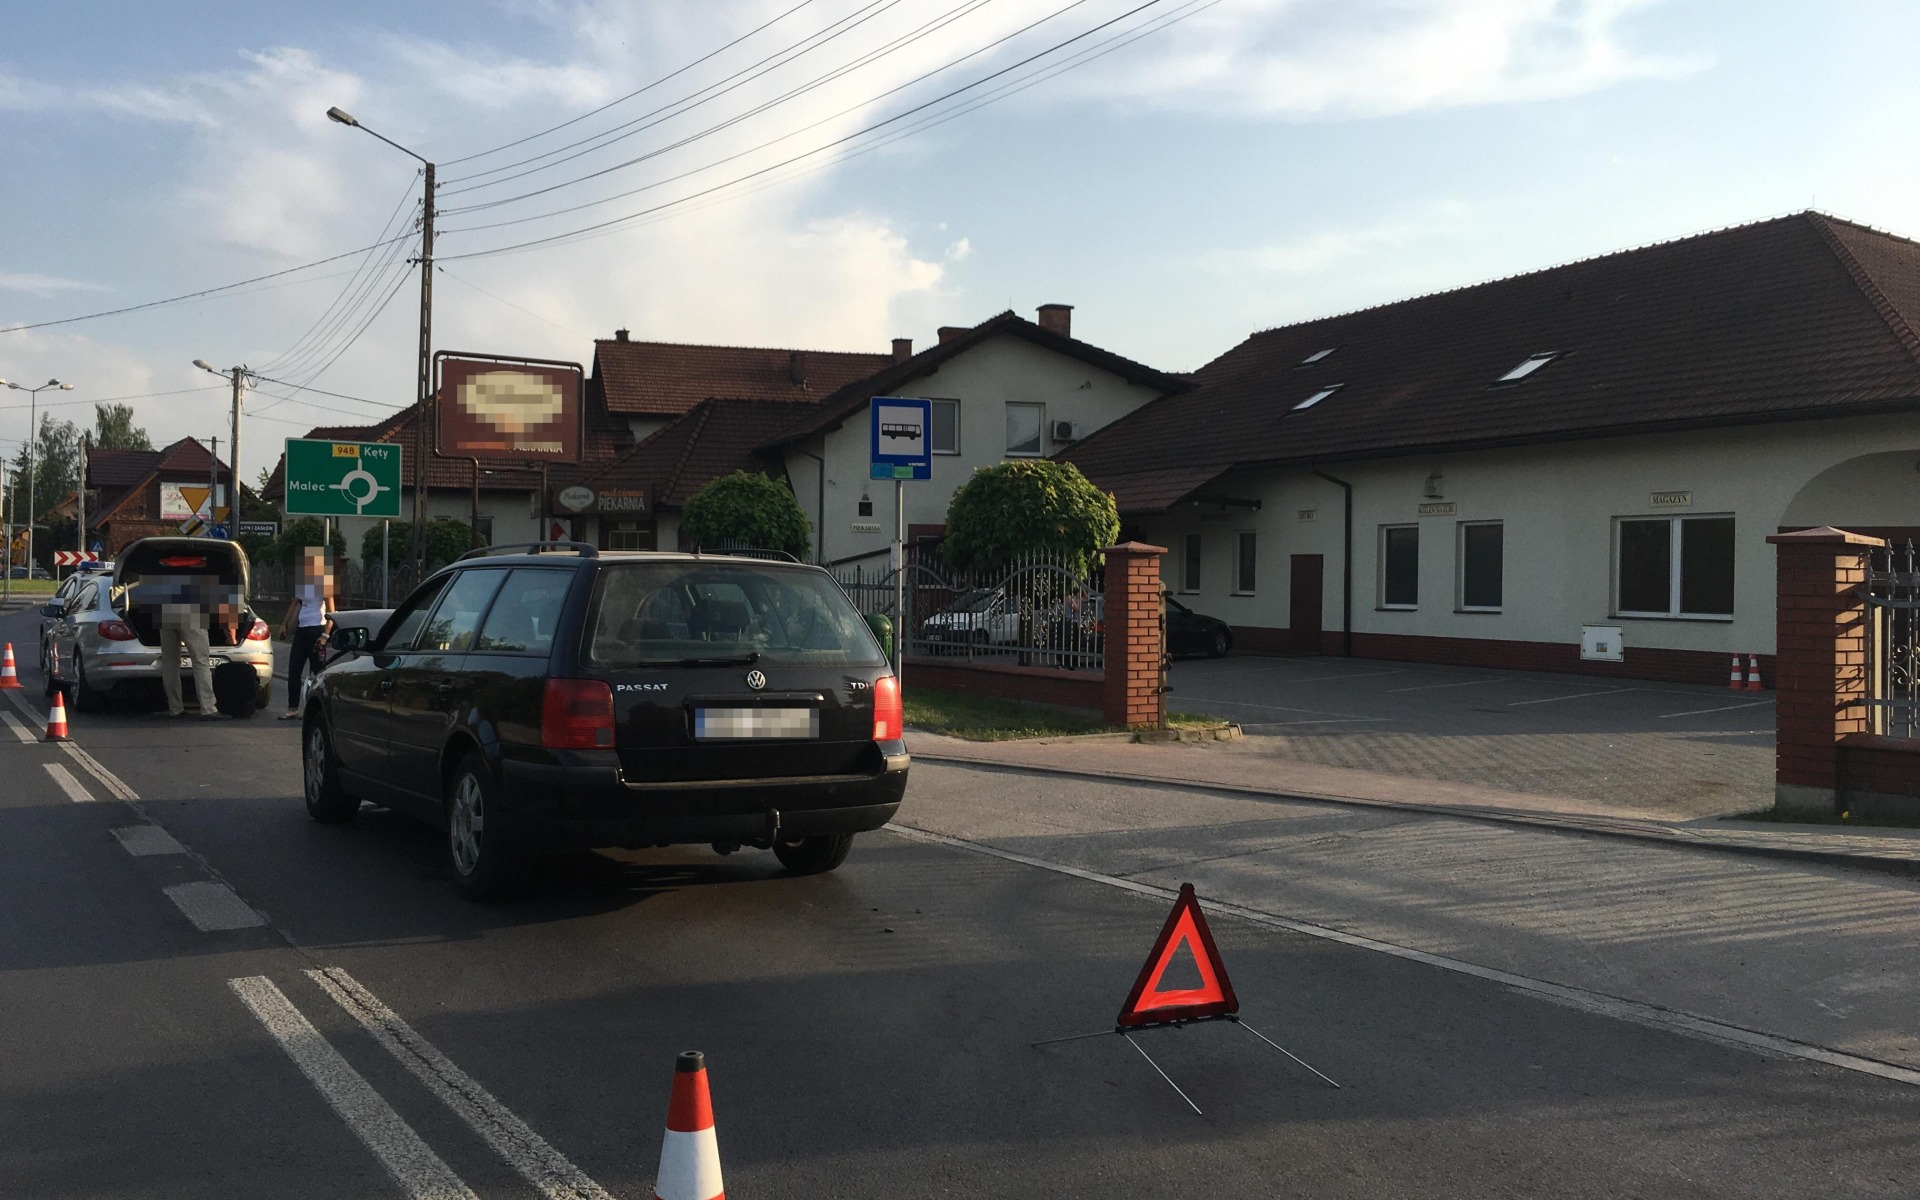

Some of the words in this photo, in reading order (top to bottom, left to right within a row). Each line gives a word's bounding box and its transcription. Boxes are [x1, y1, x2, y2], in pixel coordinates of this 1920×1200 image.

[338, 446, 355, 455] 948
[364, 446, 388, 460] Kęty
[289, 480, 326, 491] Malec
[598, 497, 645, 511] PIEKARNIA
[1652, 494, 1688, 504] MAGAZYN
[616, 683, 669, 692] PASSAT
[850, 682, 869, 690] TDI
